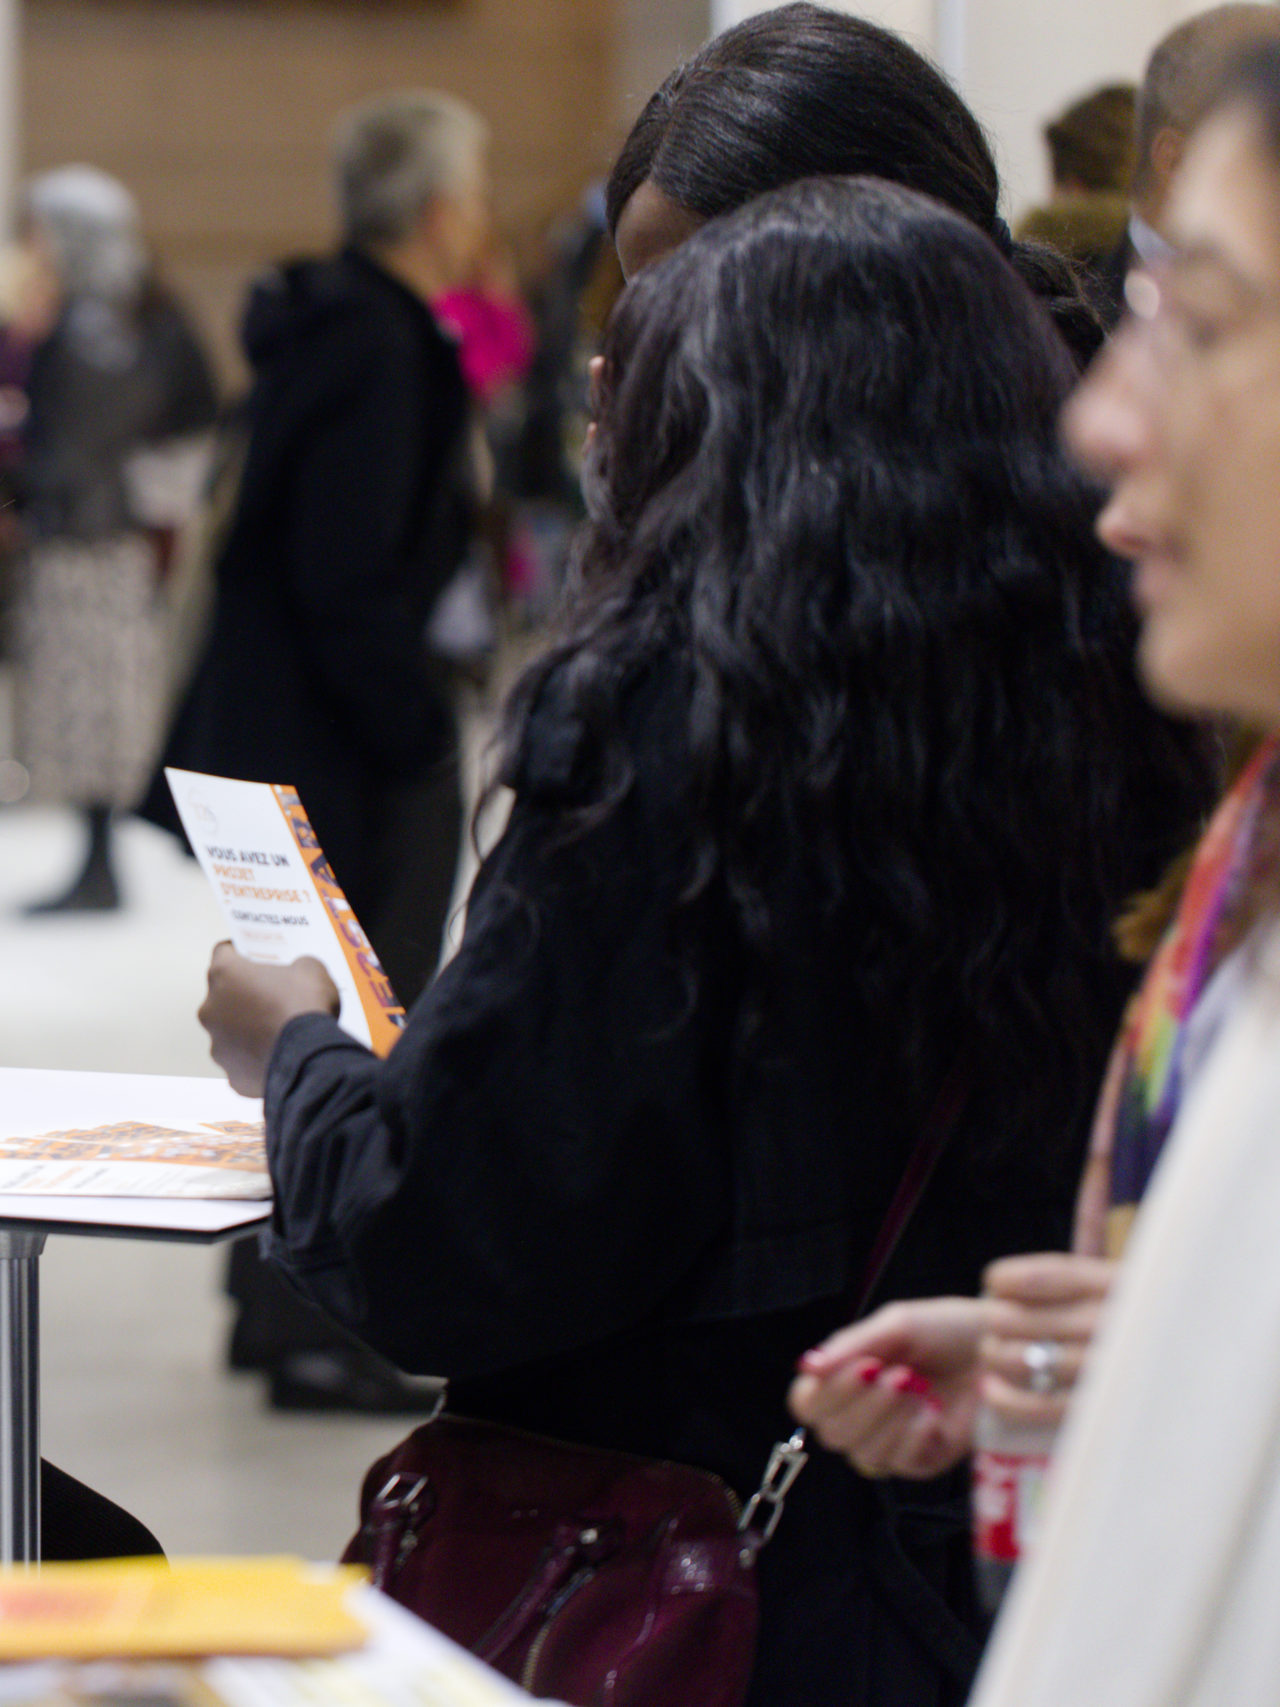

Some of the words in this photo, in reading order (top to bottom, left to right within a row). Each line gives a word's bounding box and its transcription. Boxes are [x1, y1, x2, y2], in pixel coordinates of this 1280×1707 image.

[206, 845, 238, 862] VOUS
[239, 851, 271, 866] AVEZ
[271, 854, 290, 867] UN
[213, 863, 255, 881] PROJET
[220, 882, 302, 904] D'ENTREPRISE
